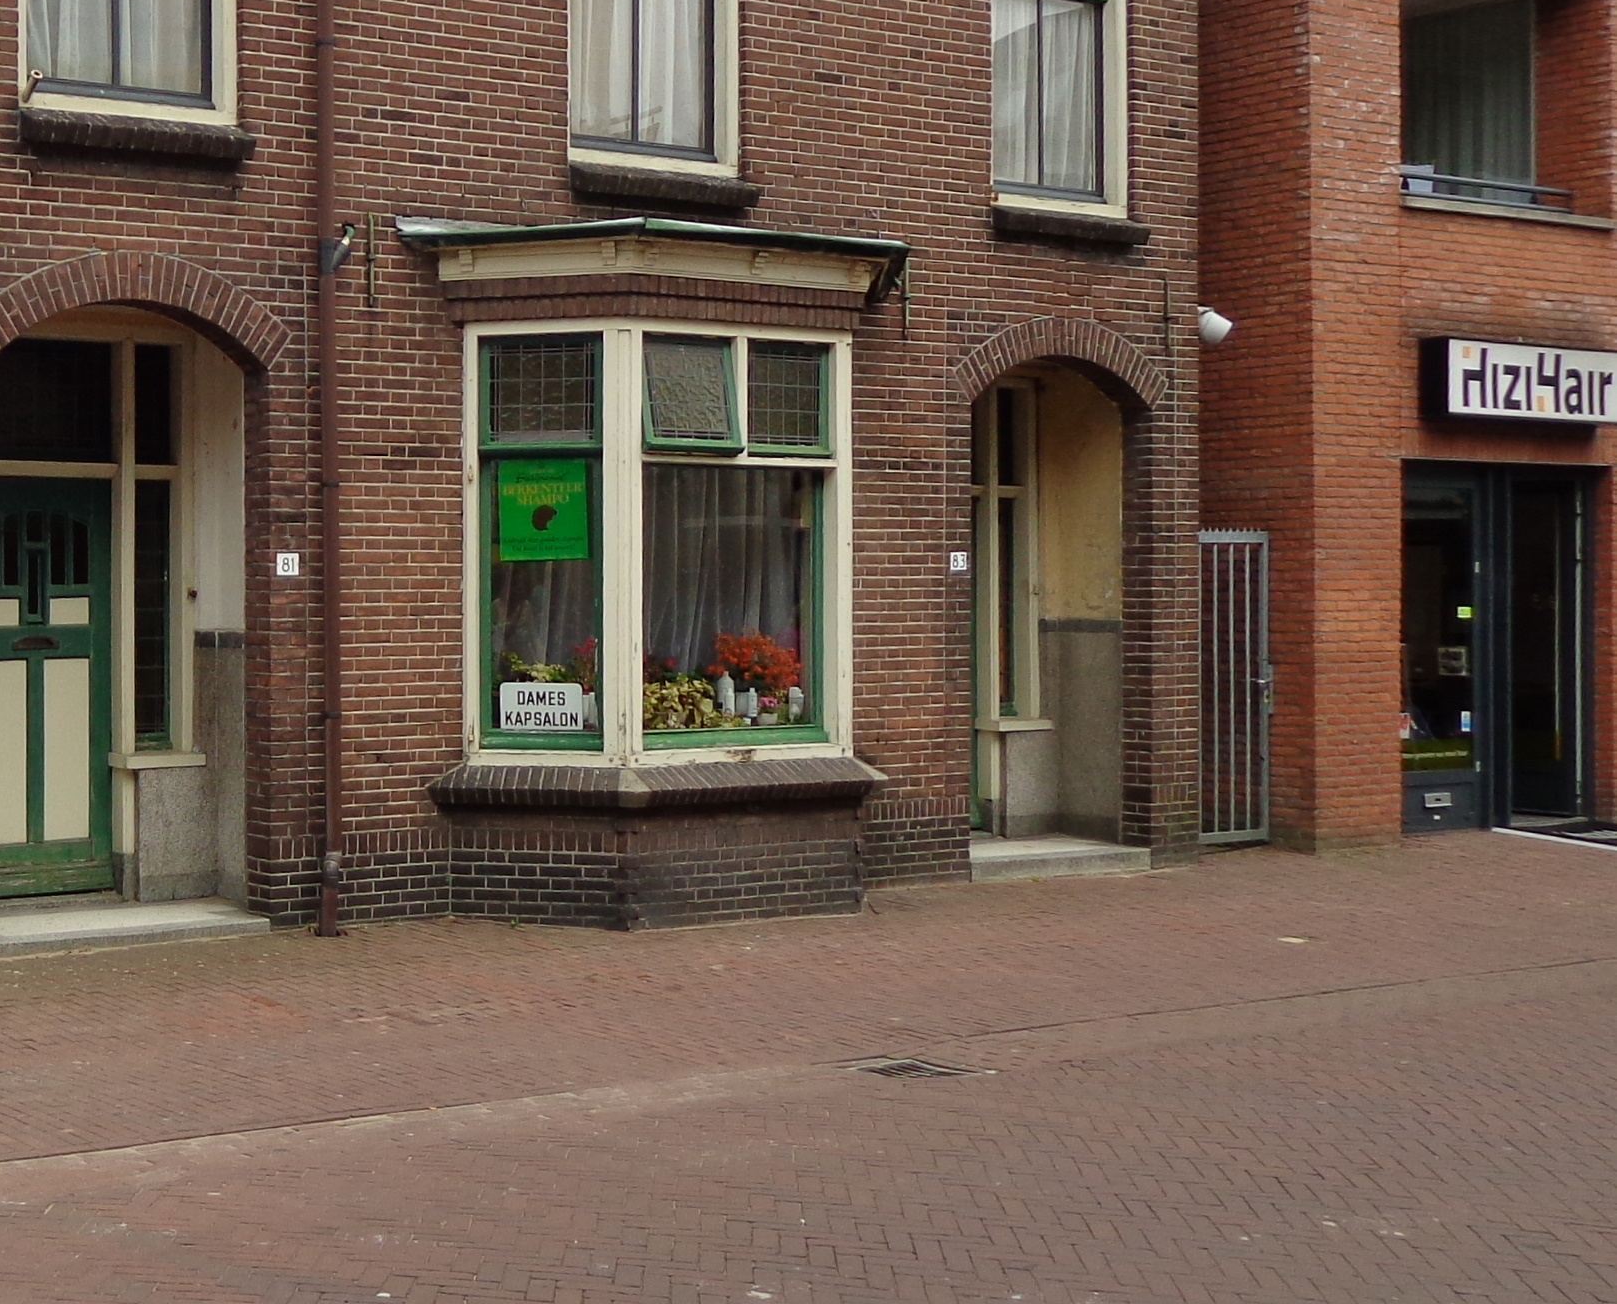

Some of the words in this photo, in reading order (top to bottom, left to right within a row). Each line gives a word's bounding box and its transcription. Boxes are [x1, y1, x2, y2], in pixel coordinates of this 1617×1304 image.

[281, 557, 295, 573] 81
[952, 553, 966, 569] 83
[517, 690, 566, 706] DAMES
[505, 710, 579, 727] KAPSALON
